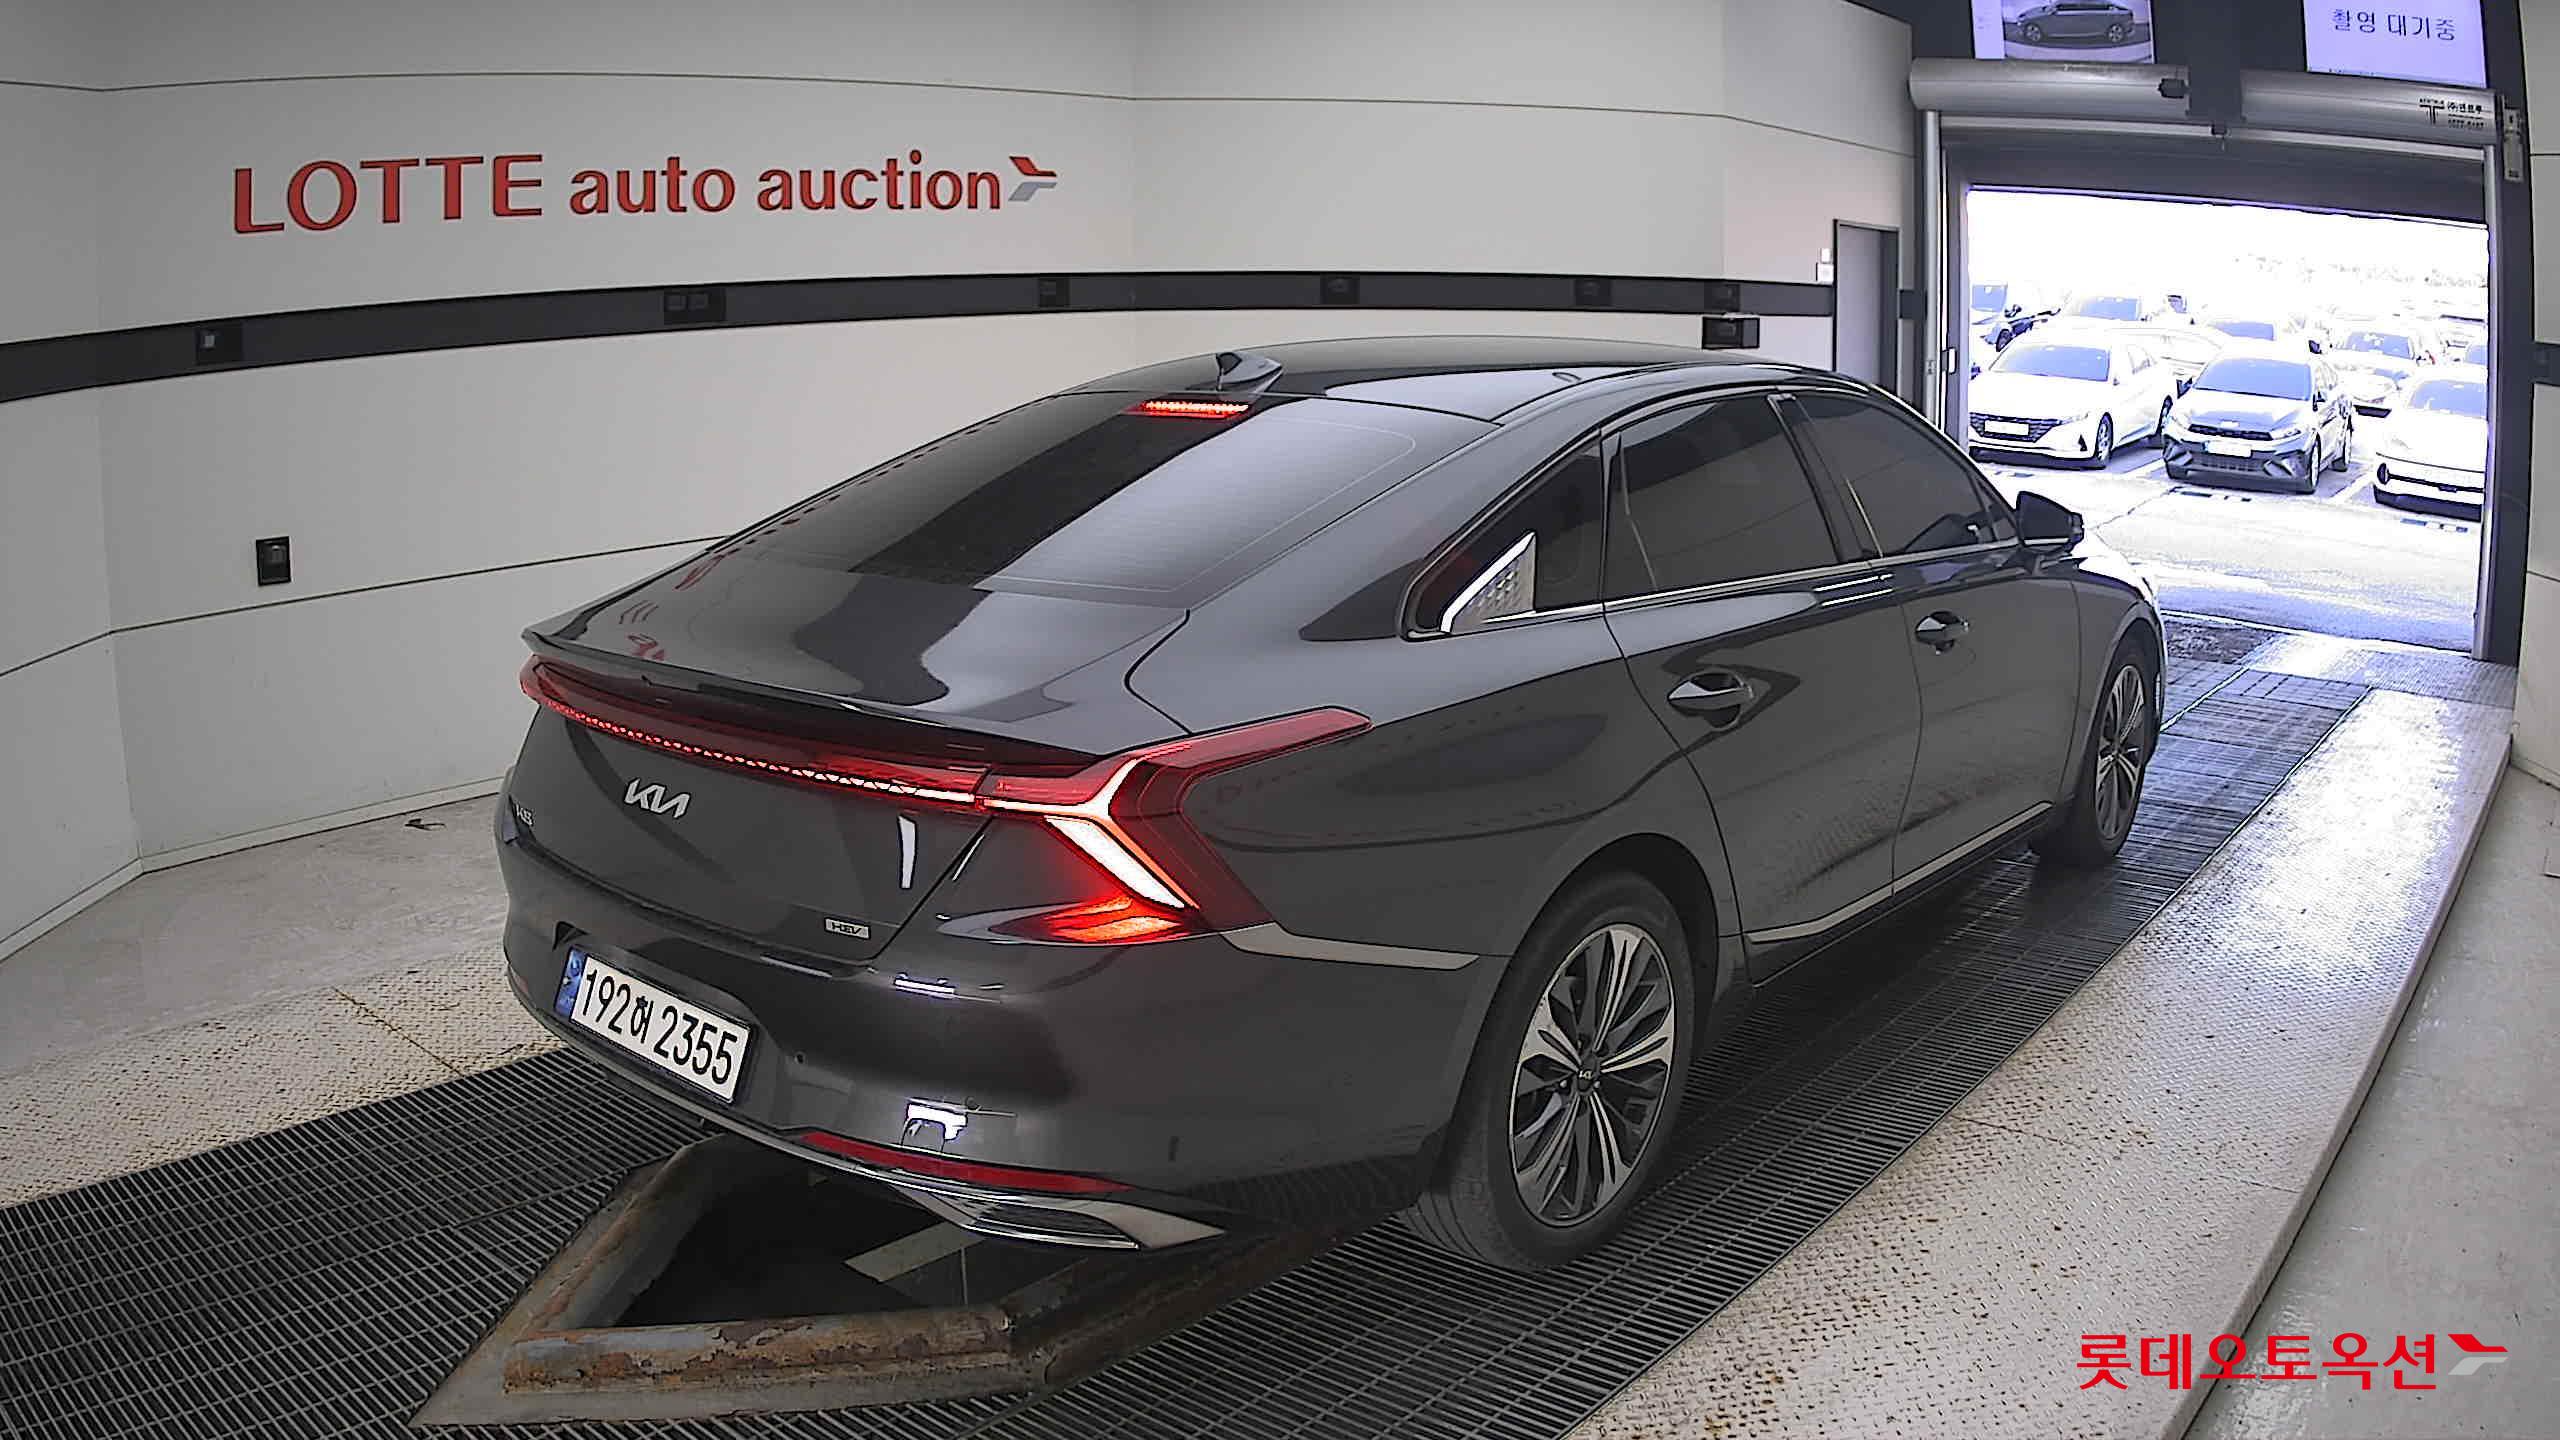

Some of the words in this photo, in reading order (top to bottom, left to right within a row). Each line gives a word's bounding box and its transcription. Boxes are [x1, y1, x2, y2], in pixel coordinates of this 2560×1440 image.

[2333, 9, 2376, 33] 촬영
[2387, 14, 2455, 41] 대기중
[233, 153, 543, 235] LOTTE
[569, 155, 736, 215] auto
[757, 149, 1001, 212] auction
[624, 778, 691, 819] KIA
[831, 920, 863, 935] HEV
[653, 1005, 739, 1086] 2355
